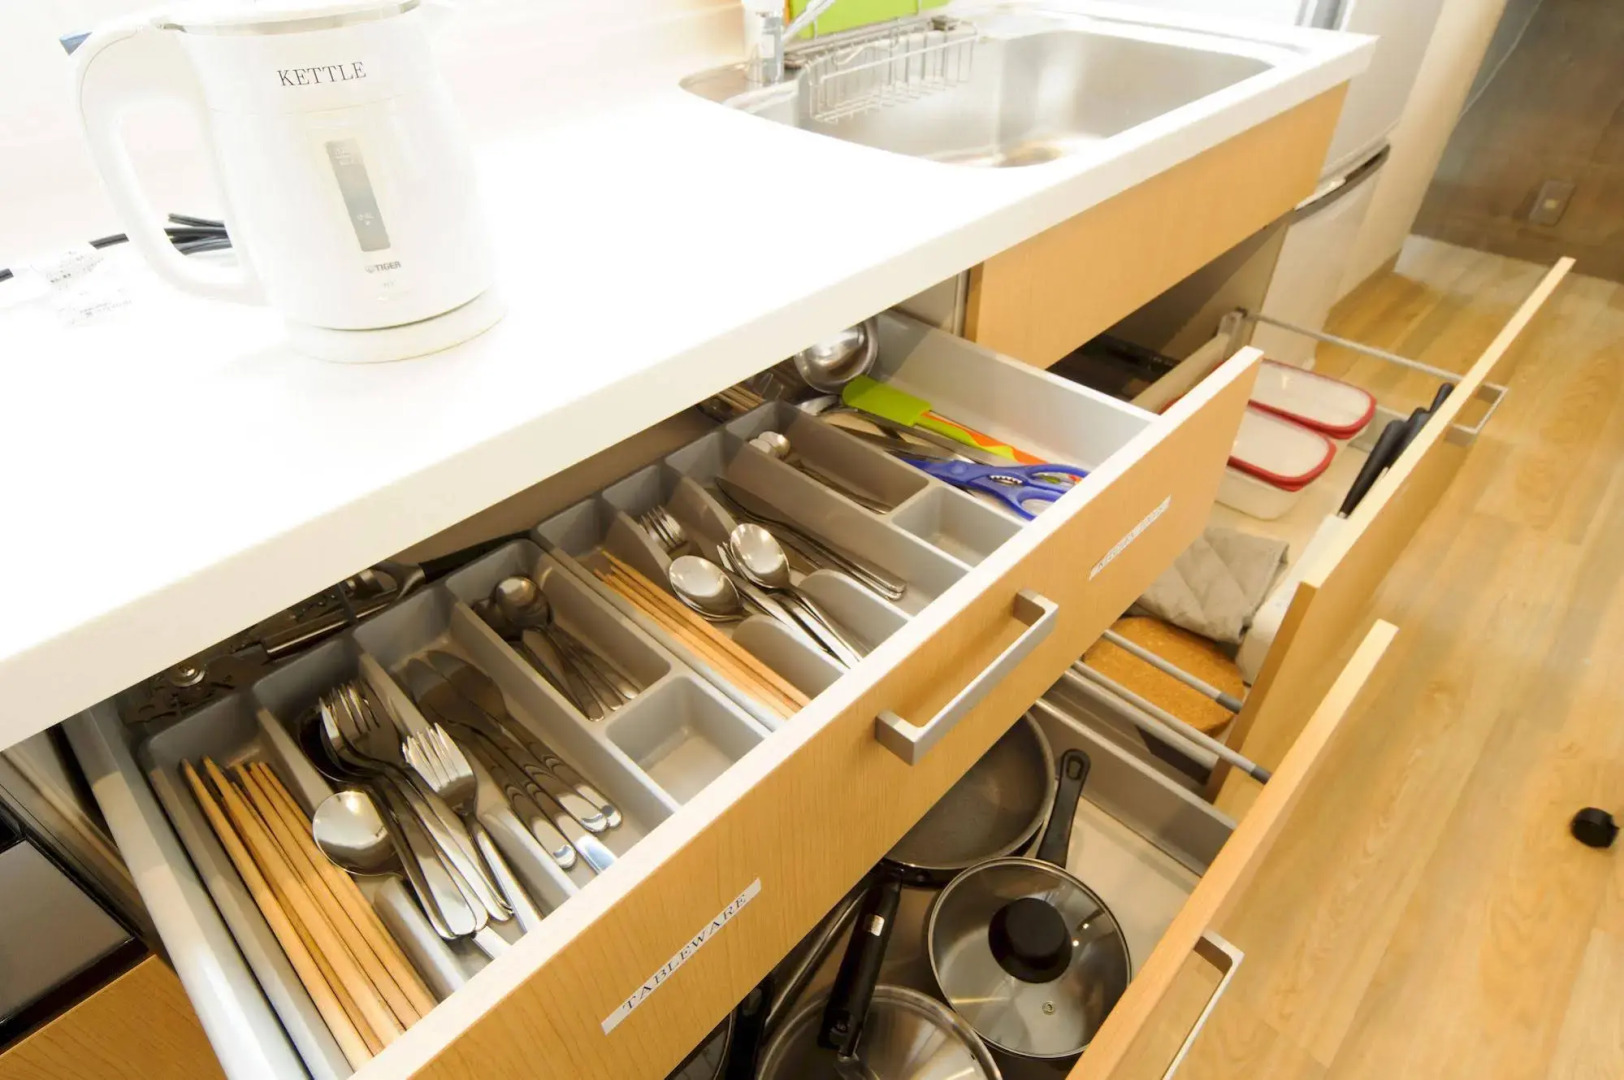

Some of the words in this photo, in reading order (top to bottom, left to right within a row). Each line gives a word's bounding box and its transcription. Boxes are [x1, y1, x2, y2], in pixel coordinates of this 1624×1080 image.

[277, 61, 367, 87] KETTLE
[375, 261, 401, 272] TIGER
[622, 893, 747, 1011] TABLEWARE
